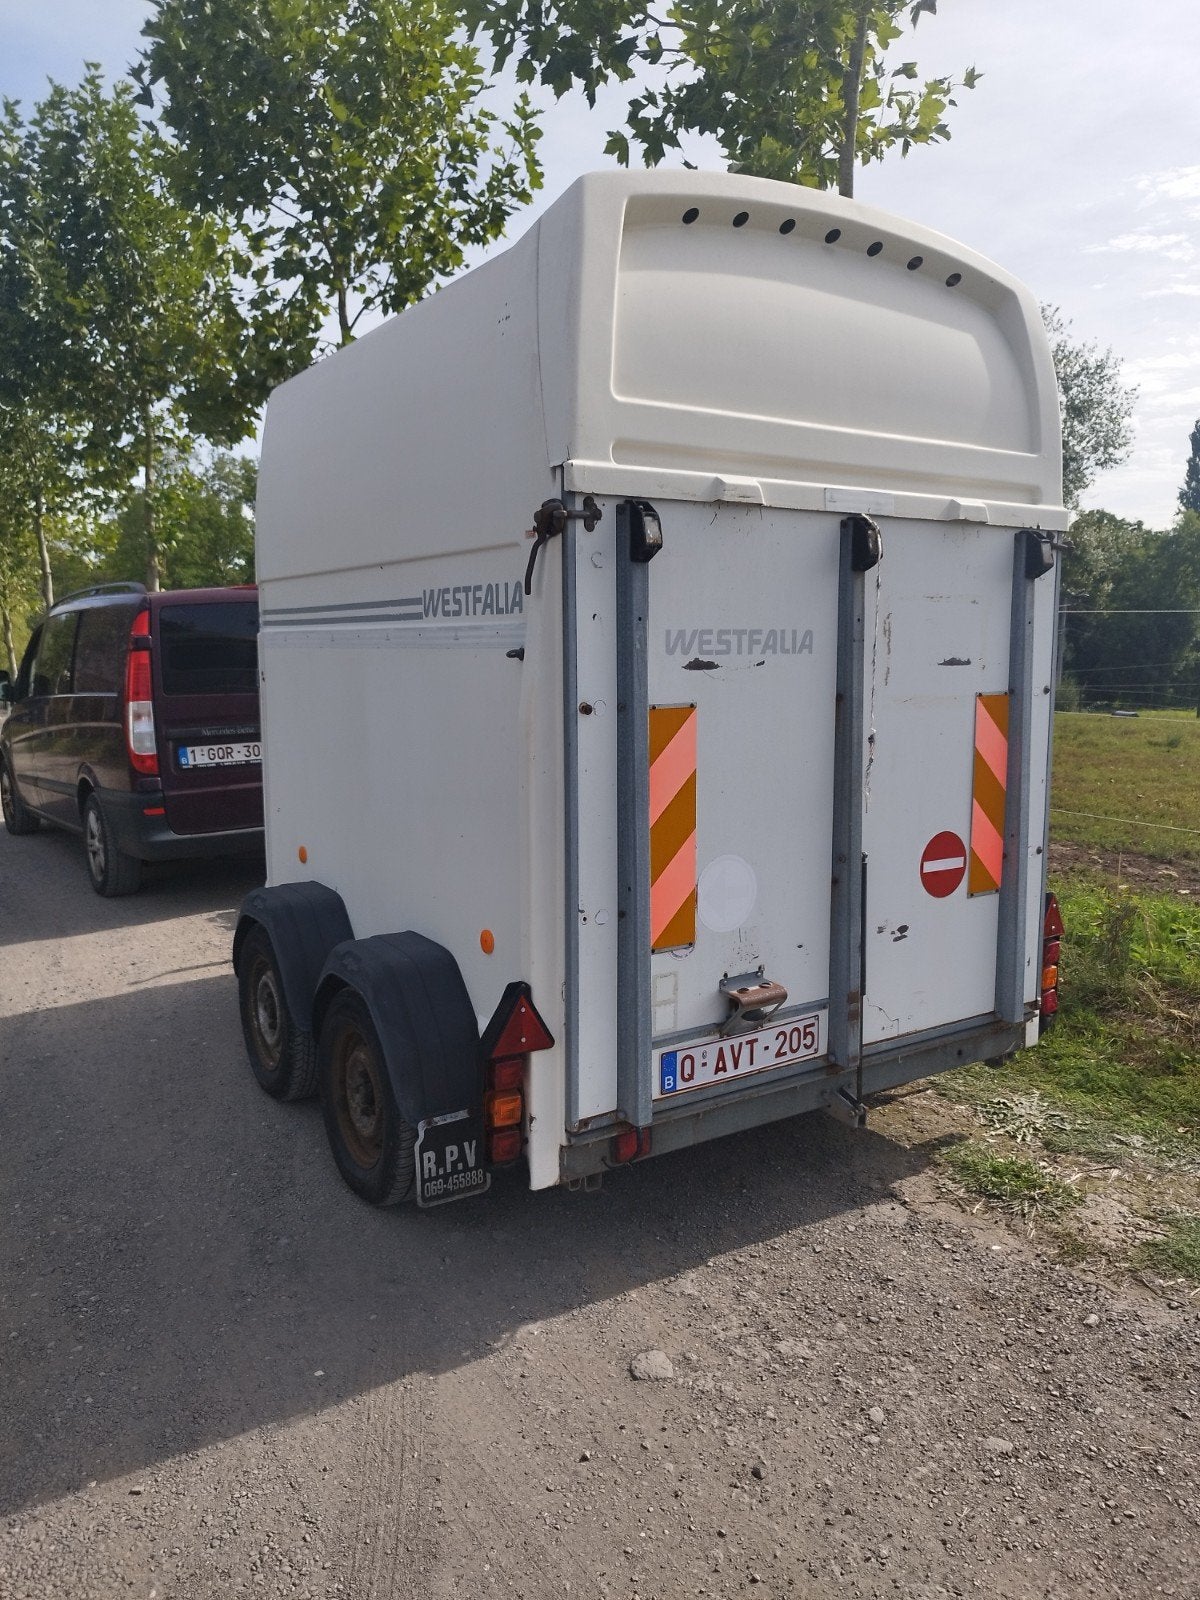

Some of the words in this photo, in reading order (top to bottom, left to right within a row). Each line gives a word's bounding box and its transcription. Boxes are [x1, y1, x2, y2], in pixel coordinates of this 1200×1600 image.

[423, 580, 523, 618] WESTFALIA
[665, 628, 814, 656] WESTFALIA
[664, 1075, 674, 1090] B
[680, 1022, 816, 1082] Q-AVT-205
[423, 1140, 477, 1179] R.P.V
[424, 1168, 484, 1198] 069-455888
